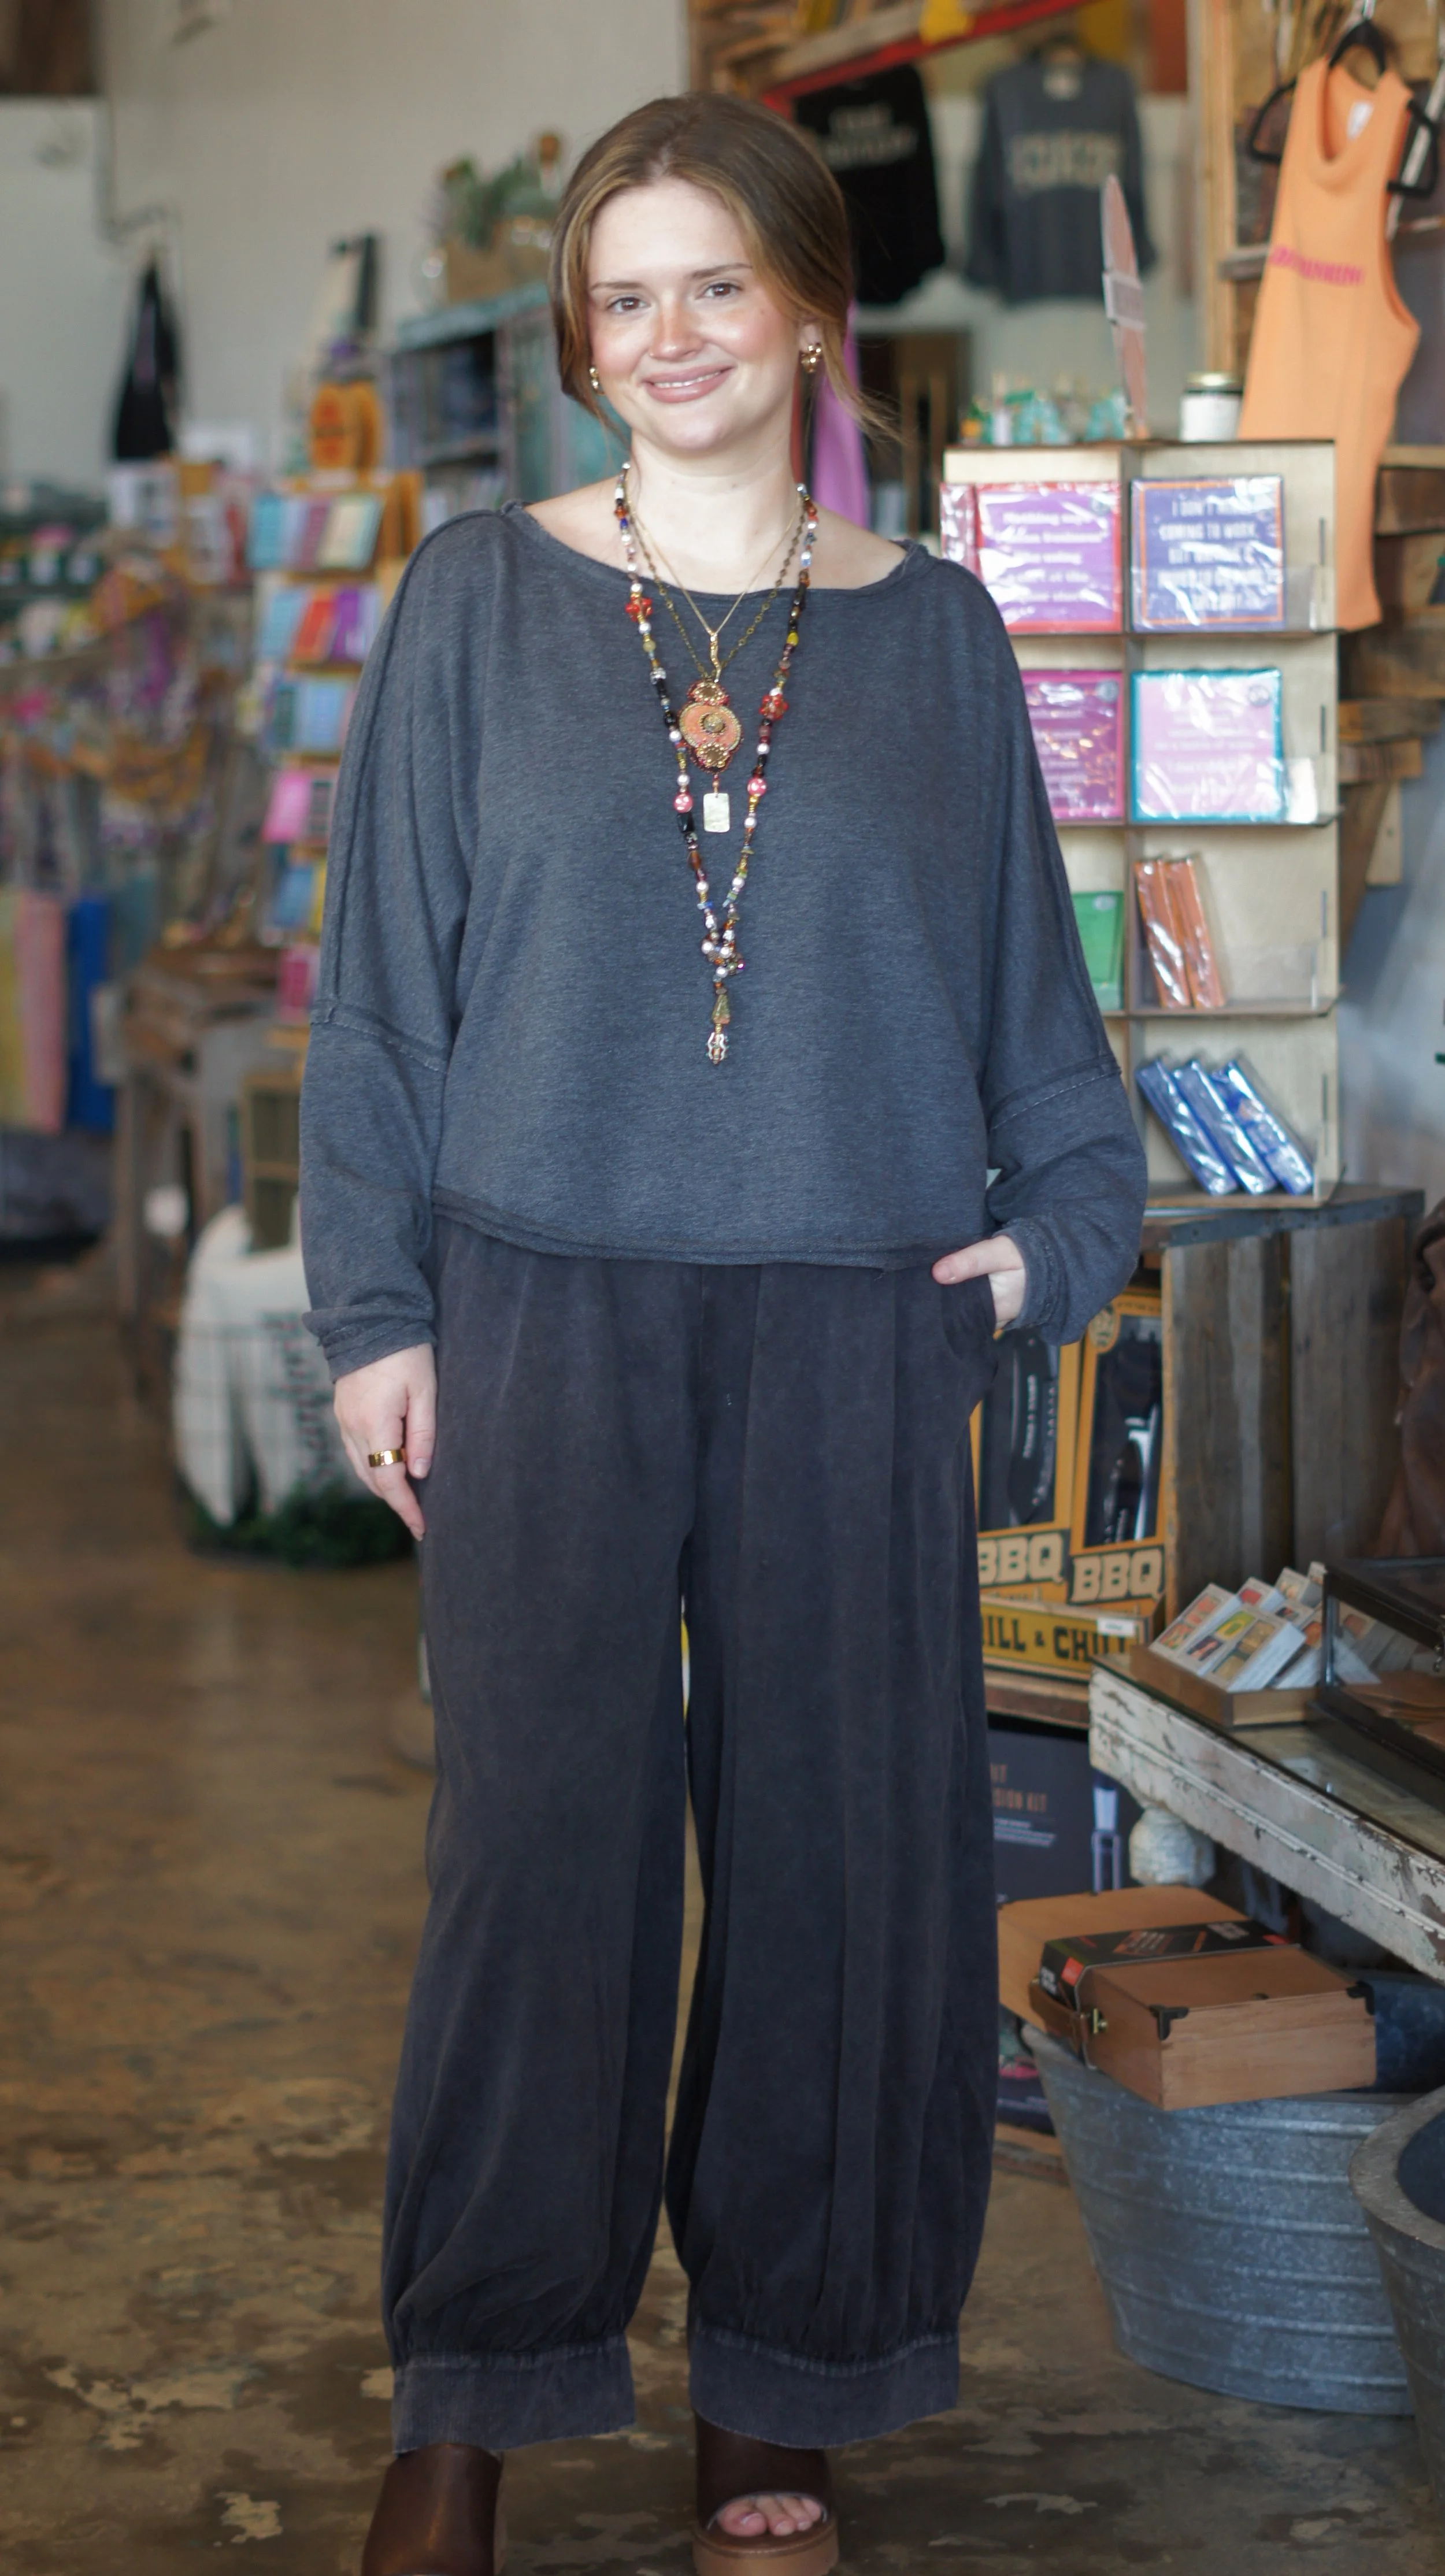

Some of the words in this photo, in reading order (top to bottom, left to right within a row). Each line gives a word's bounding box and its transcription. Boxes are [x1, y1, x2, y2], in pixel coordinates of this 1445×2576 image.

[977, 1533, 1064, 1586] BBQ
[1070, 1548, 1164, 1603] BBQ
[983, 1614, 1026, 1653] ILL
[1035, 1629, 1045, 1647] &
